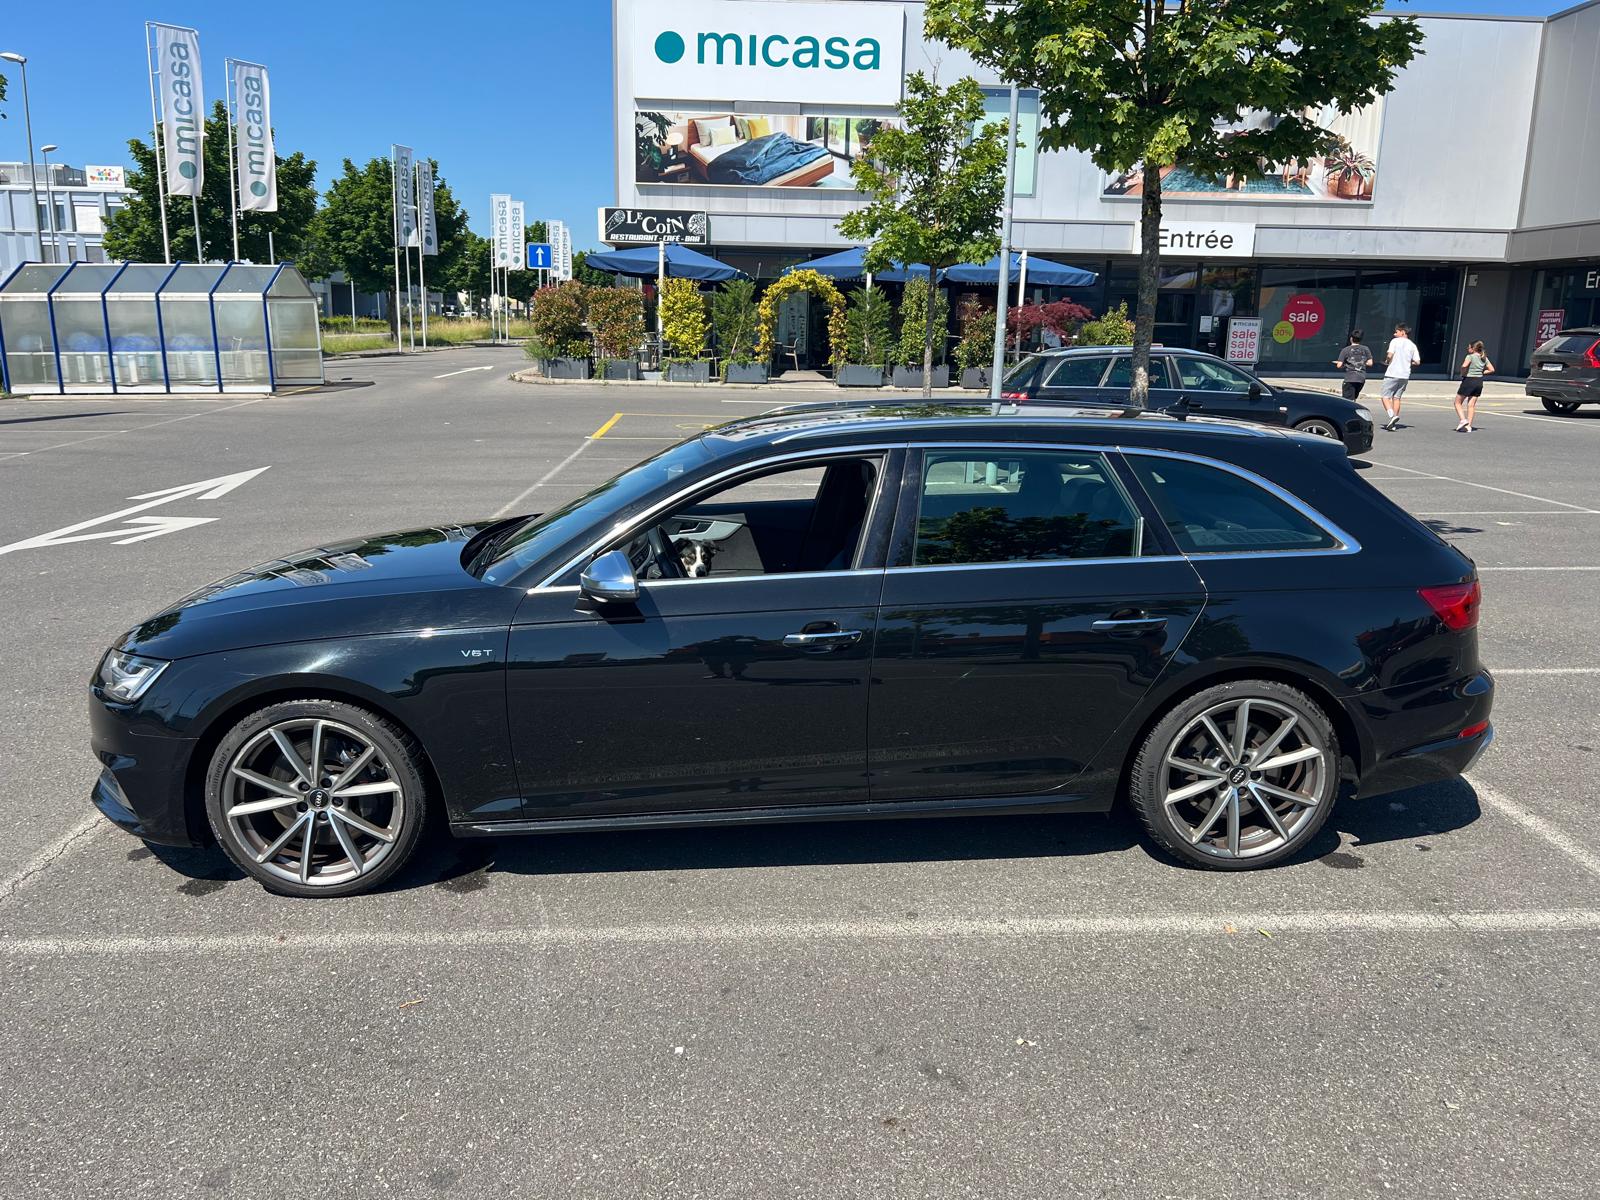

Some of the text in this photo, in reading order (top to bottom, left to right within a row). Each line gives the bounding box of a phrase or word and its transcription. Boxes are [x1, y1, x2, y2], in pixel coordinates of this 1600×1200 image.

[697, 32, 881, 70] micasa
[170, 41, 196, 156] micasa
[244, 76, 265, 176] micasa
[399, 156, 411, 223] micasa
[422, 171, 431, 233] micasa
[498, 200, 508, 250] micasa
[511, 207, 521, 254] micasa
[610, 233, 658, 241] RESTAURANT
[663, 234, 680, 242] CAFÉ
[1158, 229, 1234, 250] Entrée
[552, 225, 560, 264] micasa
[561, 231, 569, 268] micasa
[1231, 329, 1257, 339] sale
[1288, 310, 1318, 323] sale
[1229, 349, 1255, 359] sale
[1230, 339, 1256, 349] sale
[461, 649, 493, 657] V6T
